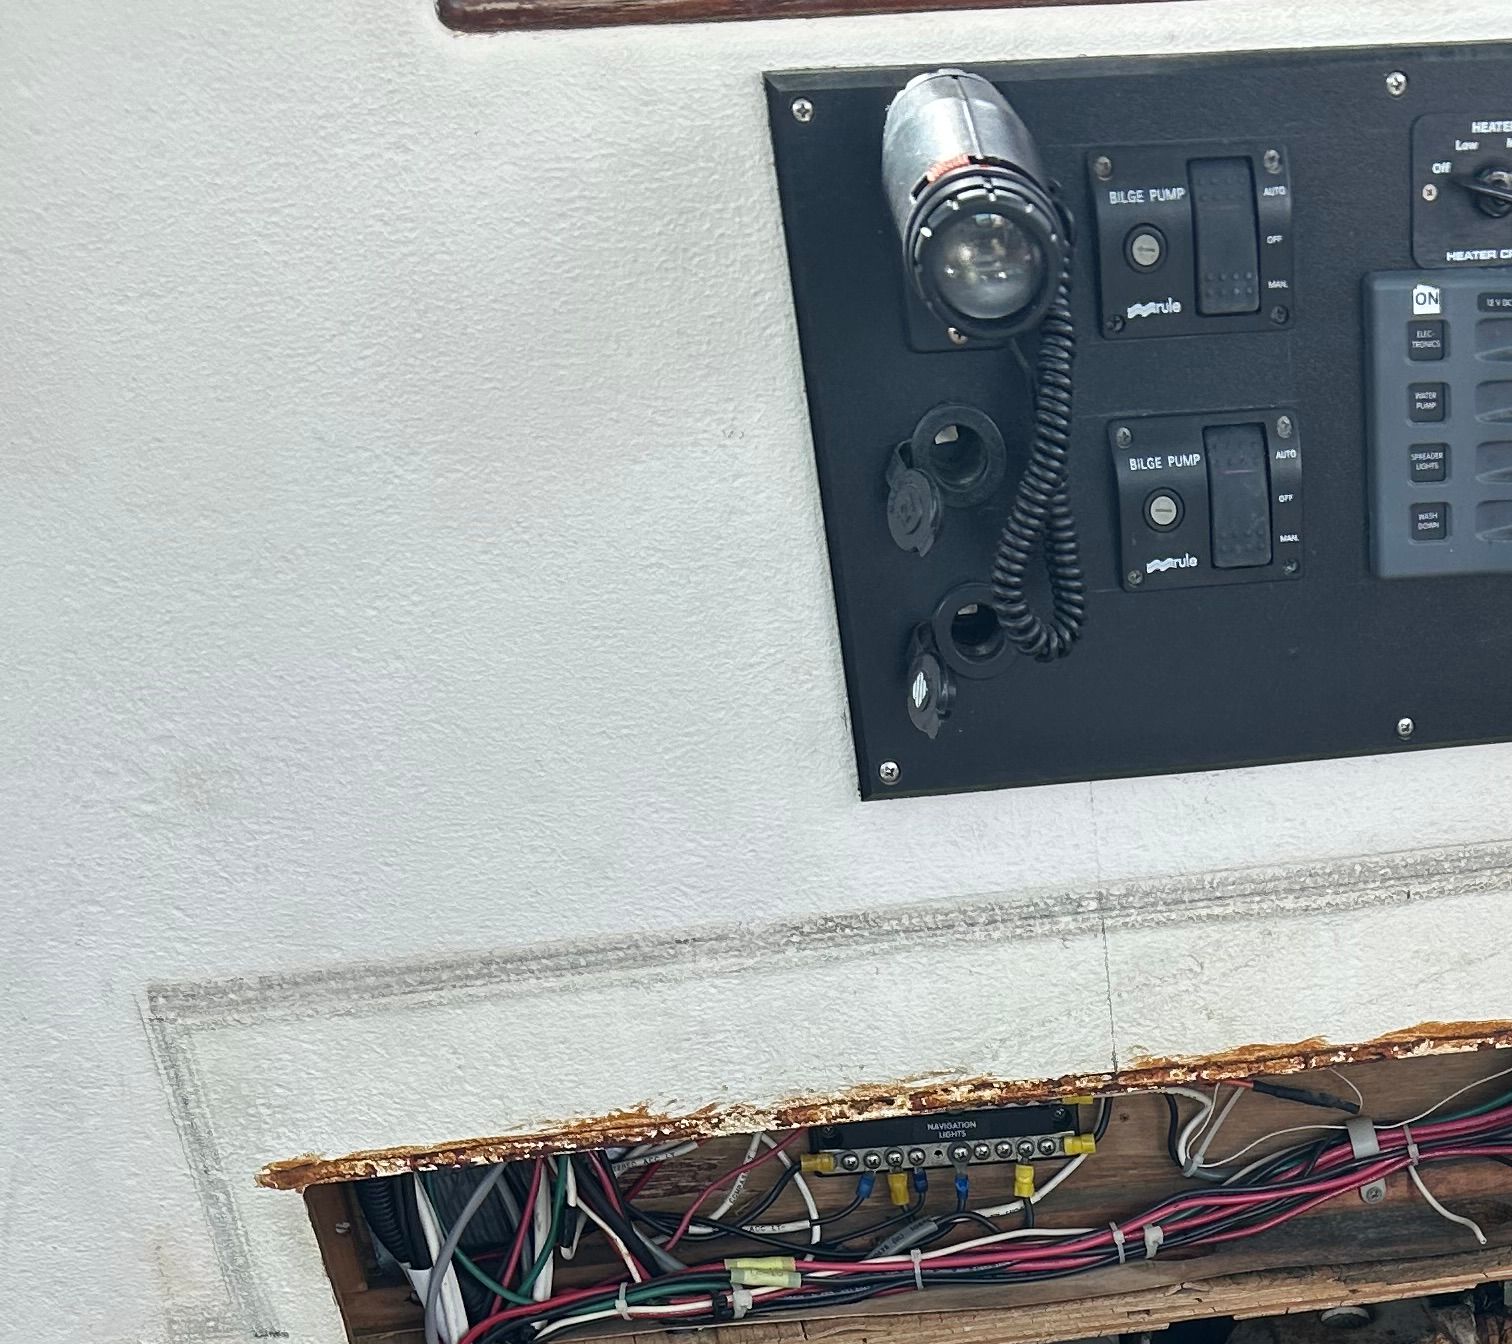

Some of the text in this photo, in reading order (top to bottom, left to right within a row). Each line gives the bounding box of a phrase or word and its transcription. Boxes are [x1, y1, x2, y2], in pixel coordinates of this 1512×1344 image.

[1455, 139, 1478, 151] Low
[1432, 161, 1452, 174] Off
[1109, 187, 1185, 205] BILGE PUMP
[1263, 186, 1287, 197] AUTO
[1266, 235, 1284, 244] OFF
[1446, 250, 1497, 262] HEATER
[1415, 291, 1440, 306] ON
[1275, 449, 1297, 460] AUTO
[1410, 451, 1444, 462] SPREADER
[1129, 453, 1201, 471] BILGE PUMP
[1415, 461, 1440, 471] LIGHTS
[1278, 494, 1294, 503] OFF
[927, 1120, 977, 1131] NAVIGATION
[938, 1130, 967, 1139] LIGHTS
